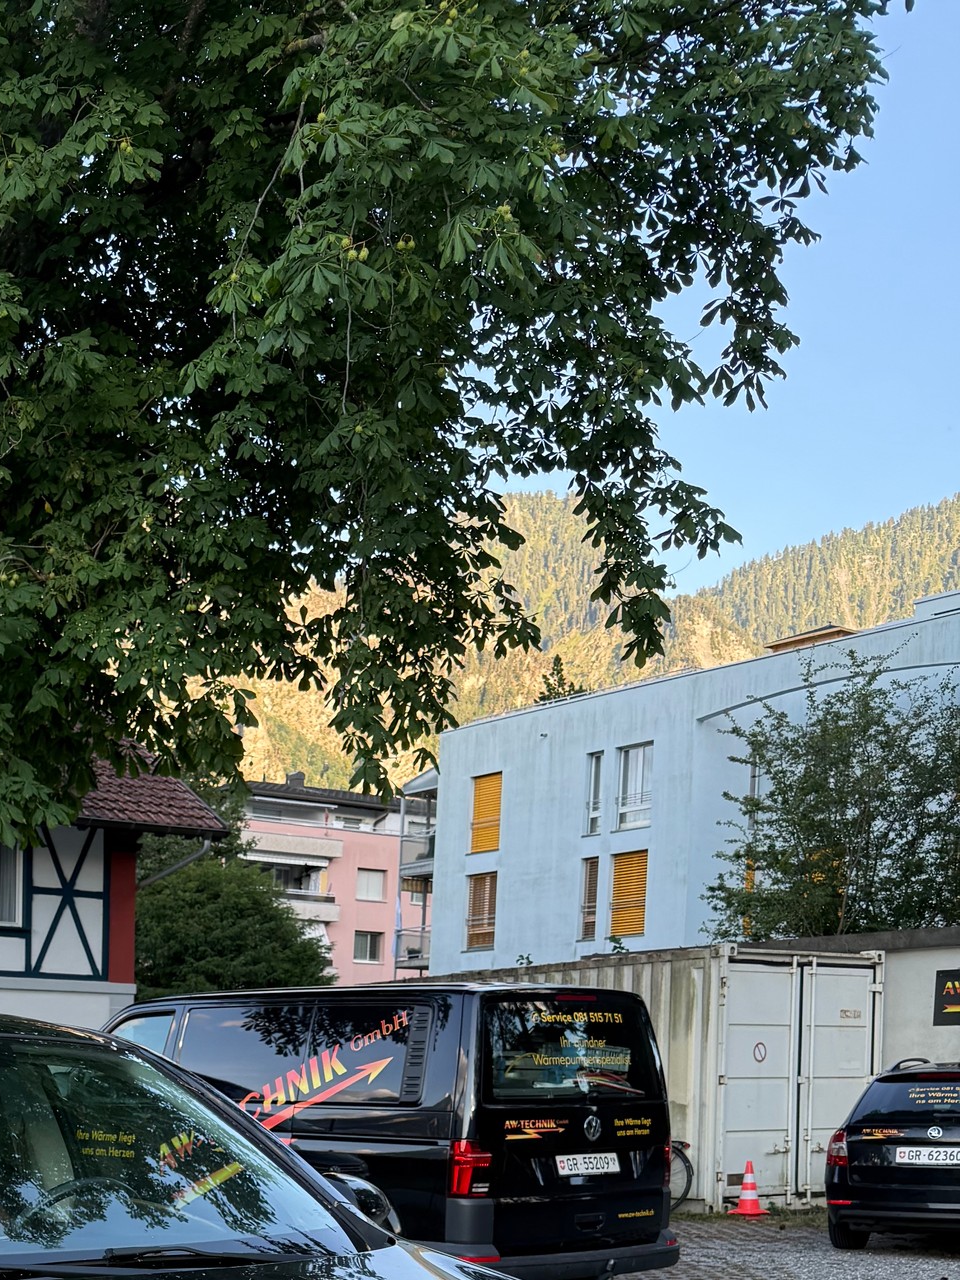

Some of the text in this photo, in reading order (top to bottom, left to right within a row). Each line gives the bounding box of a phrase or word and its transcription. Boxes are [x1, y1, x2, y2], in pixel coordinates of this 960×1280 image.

[541, 1012, 623, 1024] Service 081 515 71 51
[350, 1010, 409, 1052] GmbH
[559, 1036, 571, 1048] Ihr
[504, 1119, 557, 1130] AW-TECHNIK
[625, 1118, 641, 1127] Wärme
[76, 1130, 136, 1145] Ihre Wärme liegt
[82, 1147, 135, 1158] uns am Herzen
